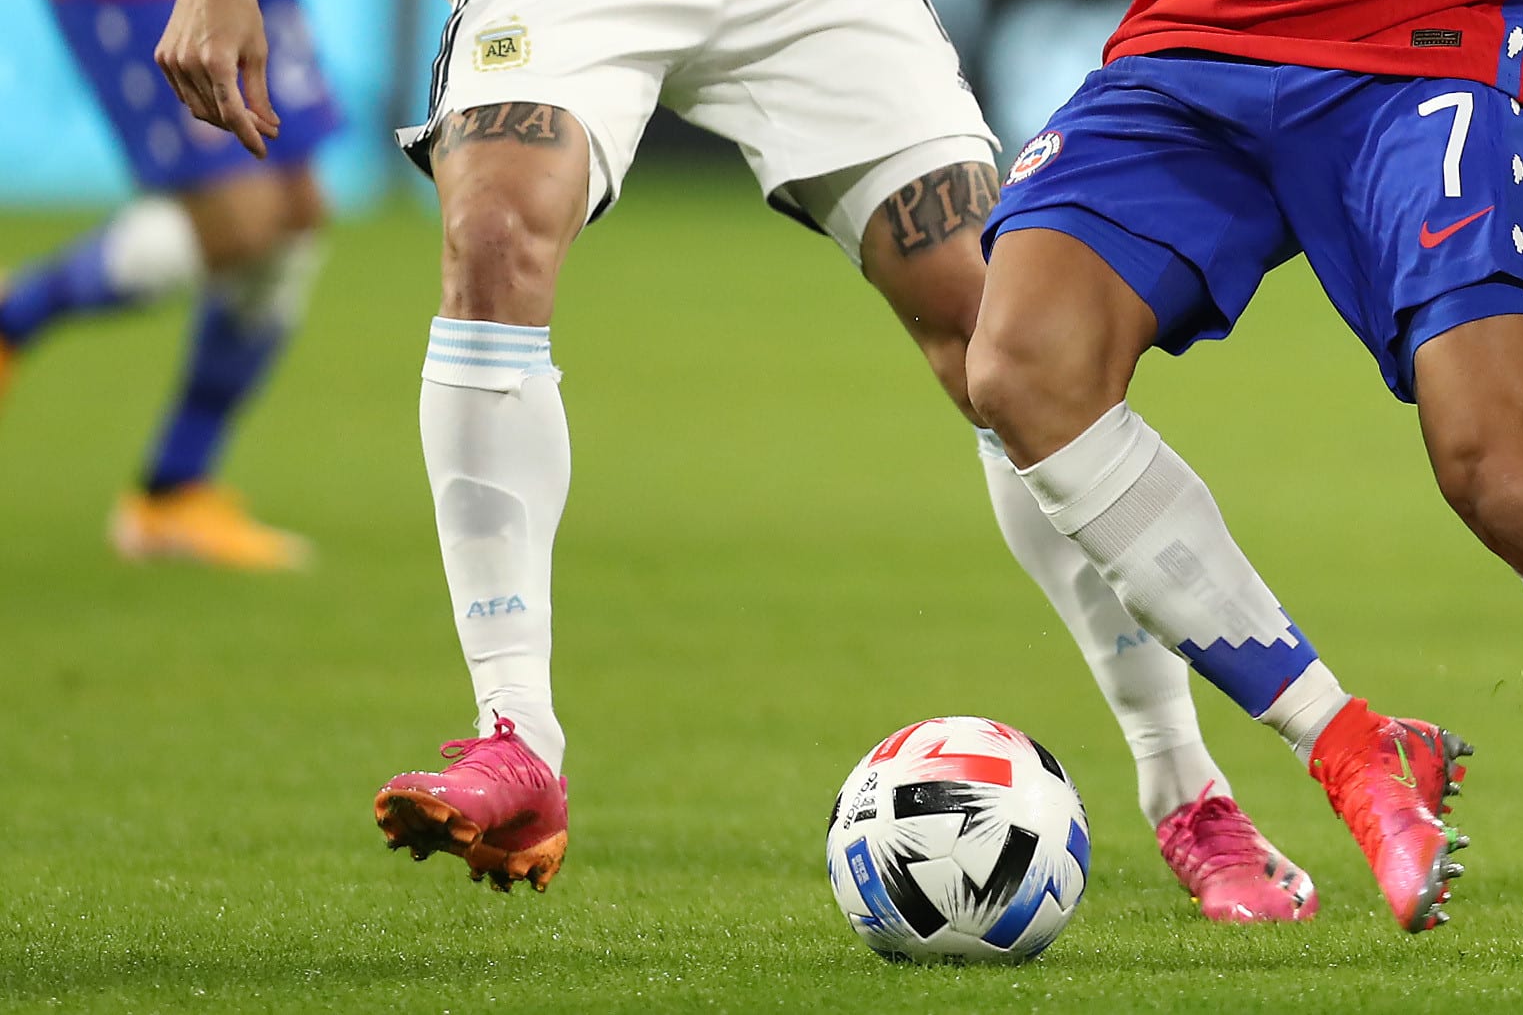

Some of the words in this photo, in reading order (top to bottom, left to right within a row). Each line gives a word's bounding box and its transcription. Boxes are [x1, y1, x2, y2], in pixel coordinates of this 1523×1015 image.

[485, 37, 518, 58] AFA
[1417, 91, 1474, 198] 7
[467, 595, 527, 618] AFA
